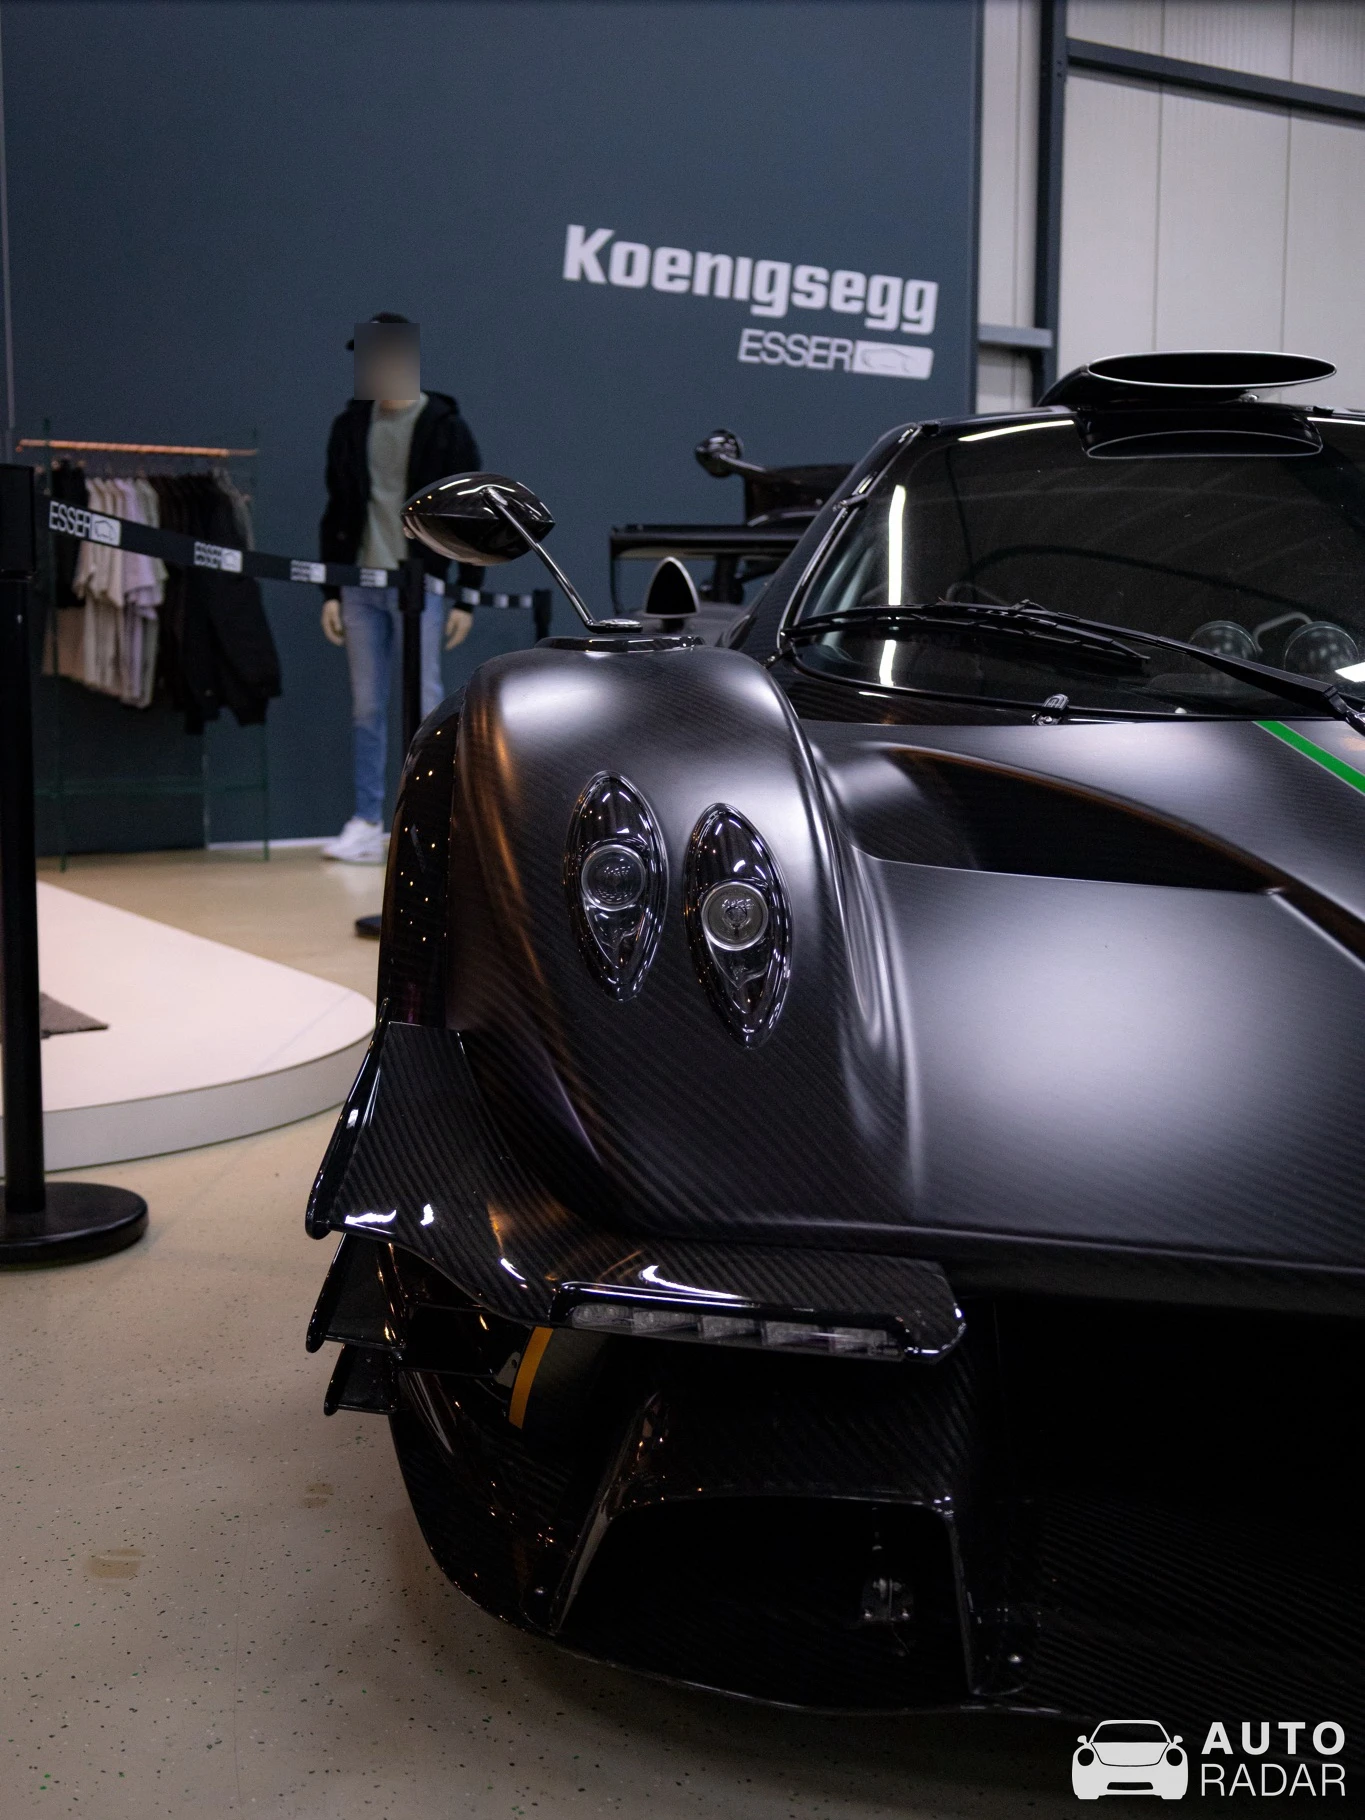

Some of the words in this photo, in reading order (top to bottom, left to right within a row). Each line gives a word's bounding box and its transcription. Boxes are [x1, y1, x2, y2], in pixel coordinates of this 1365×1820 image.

[562, 224, 938, 335] Koenigsegg
[737, 328, 853, 373] ESSER
[49, 500, 92, 538] ESSER
